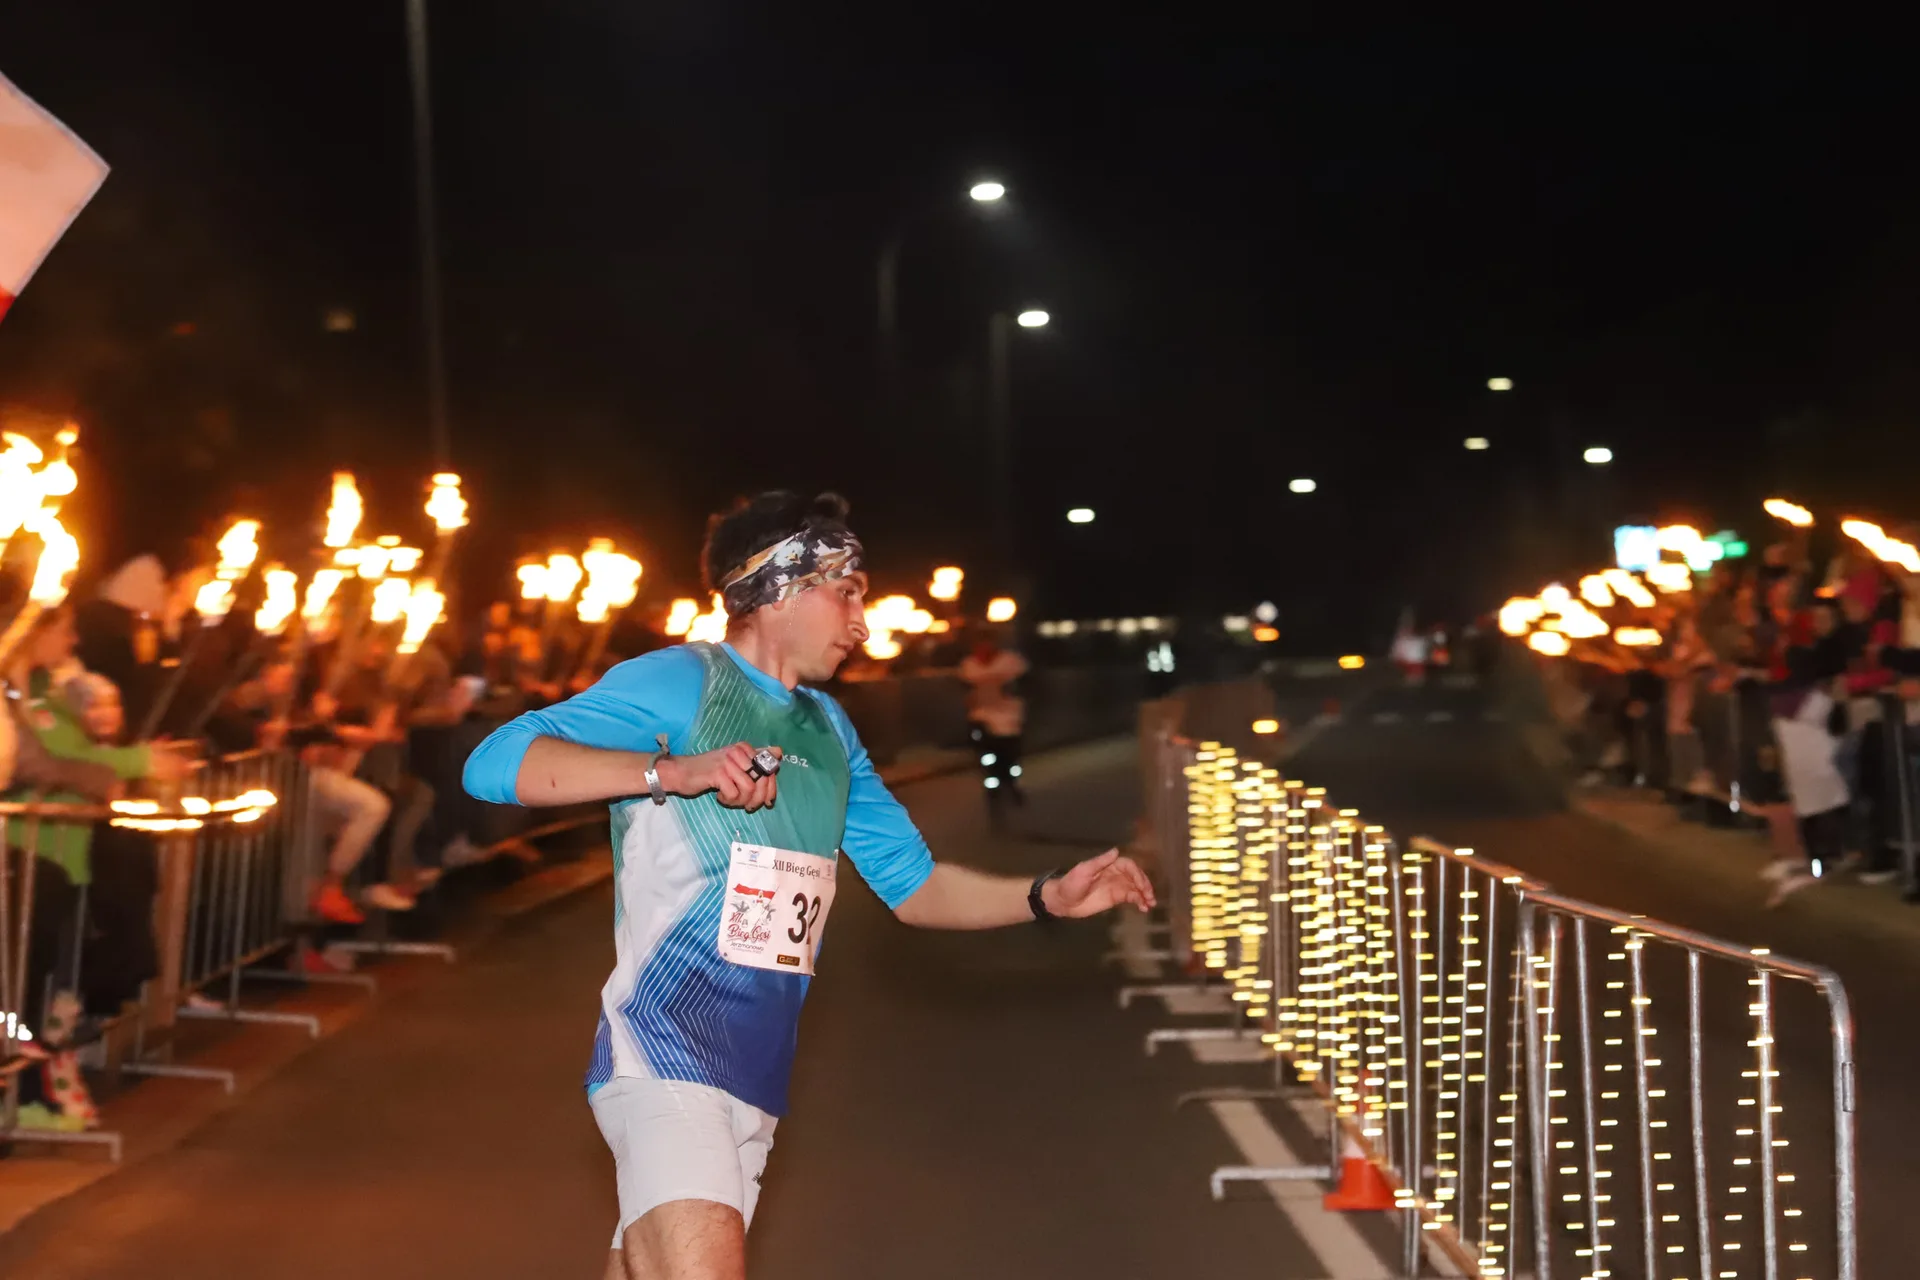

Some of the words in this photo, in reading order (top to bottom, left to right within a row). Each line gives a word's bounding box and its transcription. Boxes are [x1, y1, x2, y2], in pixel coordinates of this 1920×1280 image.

[772, 859, 785, 871] XII
[786, 861, 806, 878] Bieg
[806, 865, 821, 880] Gęsi
[727, 923, 750, 942] Bieg
